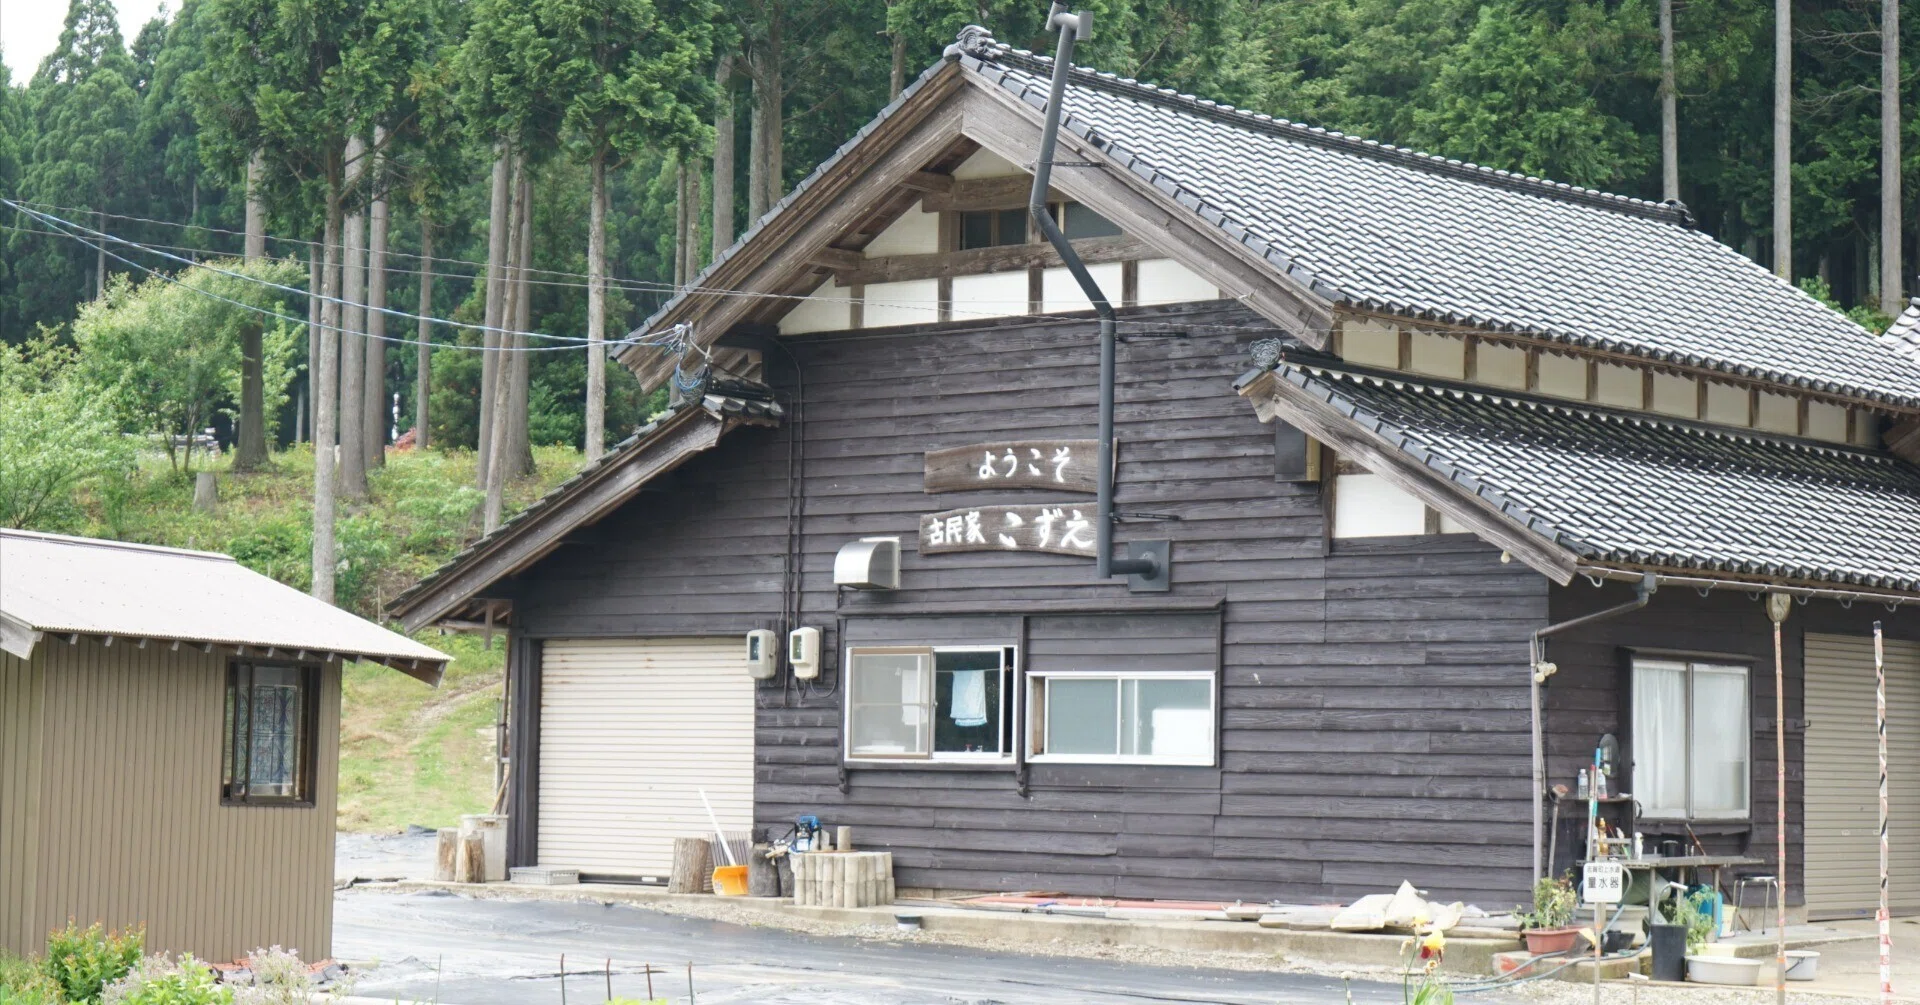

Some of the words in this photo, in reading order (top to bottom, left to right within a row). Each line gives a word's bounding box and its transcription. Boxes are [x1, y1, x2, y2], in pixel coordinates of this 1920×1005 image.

[979, 446, 1071, 483] ようこそ
[929, 511, 986, 546] 古民家
[999, 508, 1094, 548] こずえ
[1588, 877, 1619, 888] 量水器
